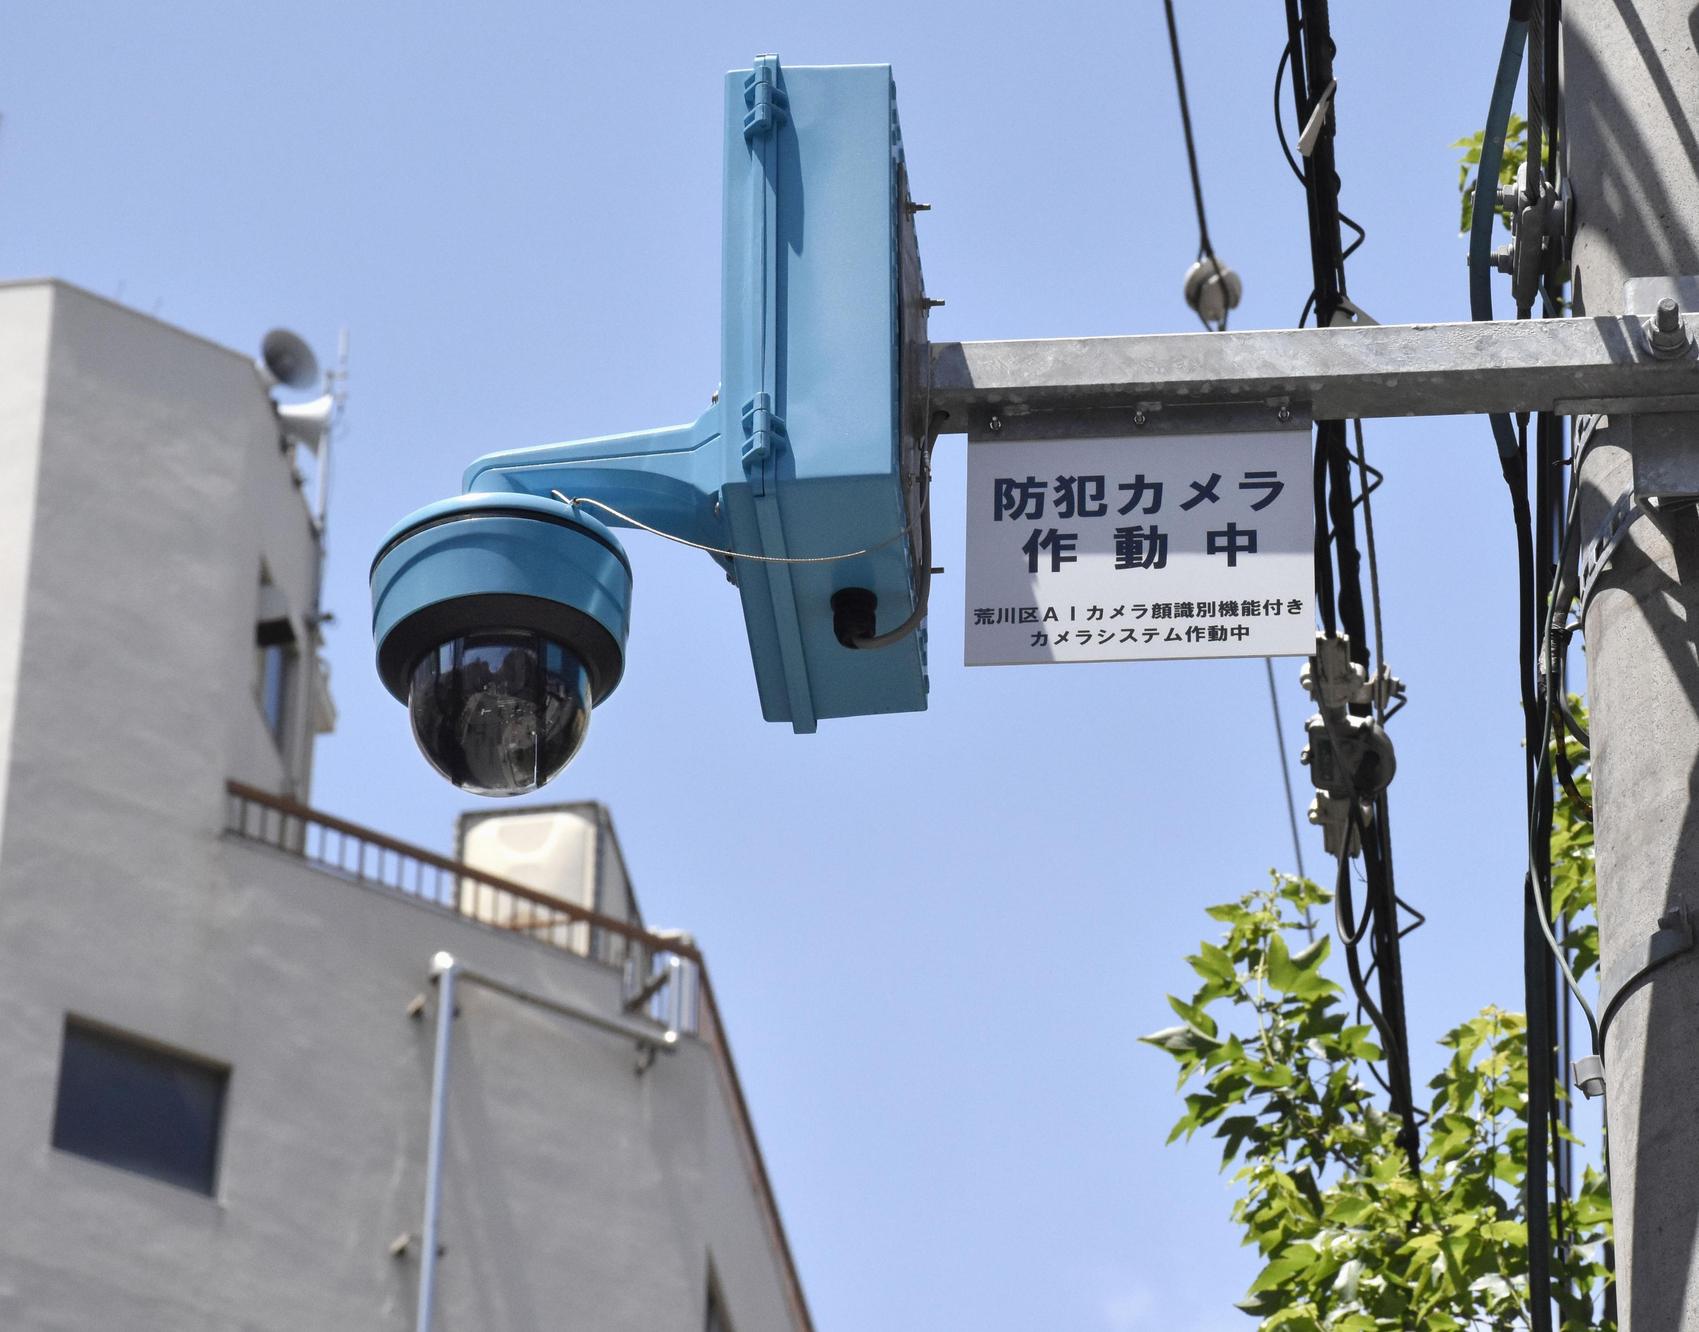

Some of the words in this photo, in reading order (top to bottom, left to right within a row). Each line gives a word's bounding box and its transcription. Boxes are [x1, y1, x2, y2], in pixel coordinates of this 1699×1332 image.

[993, 471, 1285, 521] 防犯カメラ
[1022, 522, 1258, 573] 作動中
[973, 599, 1304, 626] 荒川区AIカメラ顔識別機能付き
[1030, 624, 1251, 648] カメラシステム作動中
